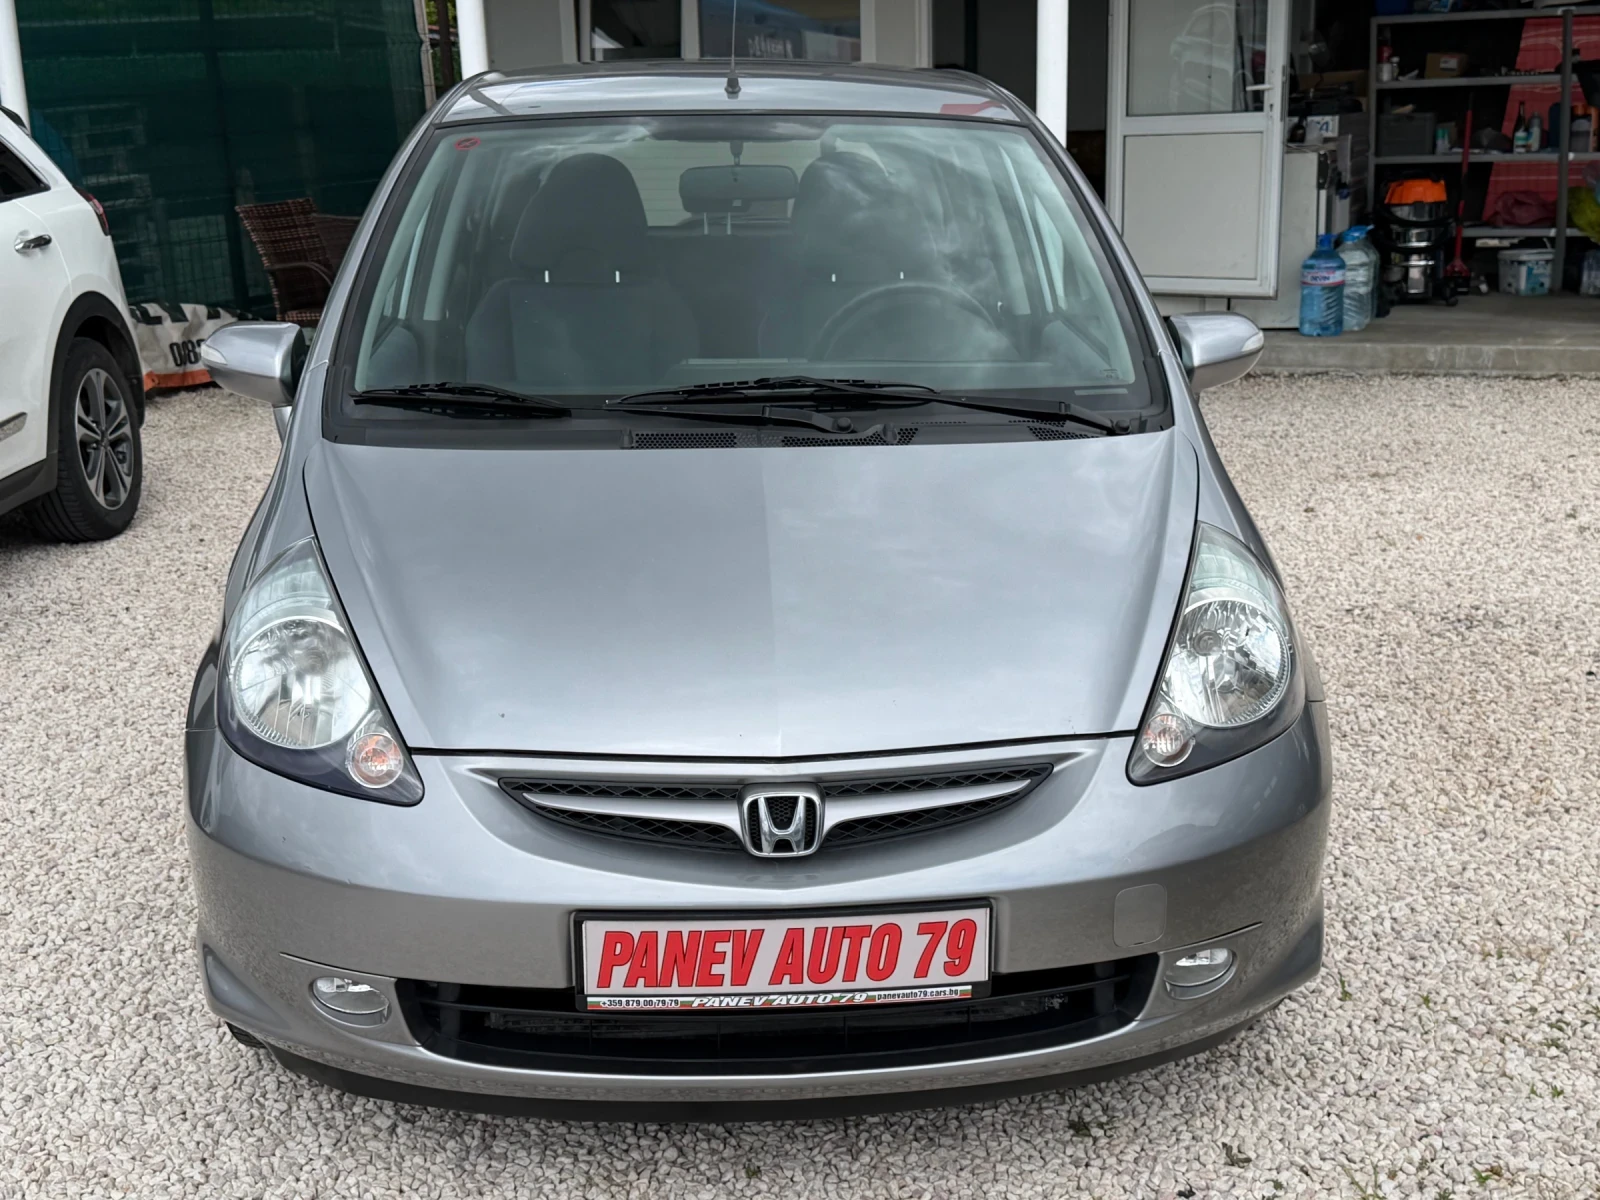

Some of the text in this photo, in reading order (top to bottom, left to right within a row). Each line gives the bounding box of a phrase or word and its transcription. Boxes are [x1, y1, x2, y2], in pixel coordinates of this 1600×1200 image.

[597, 918, 978, 989] PANEV AUTO 79
[691, 992, 869, 1007] PANEV AUTO 79
[877, 988, 960, 1001] panevauto79.cars.bg
[601, 999, 679, 1007] +359 879 00 79 79
